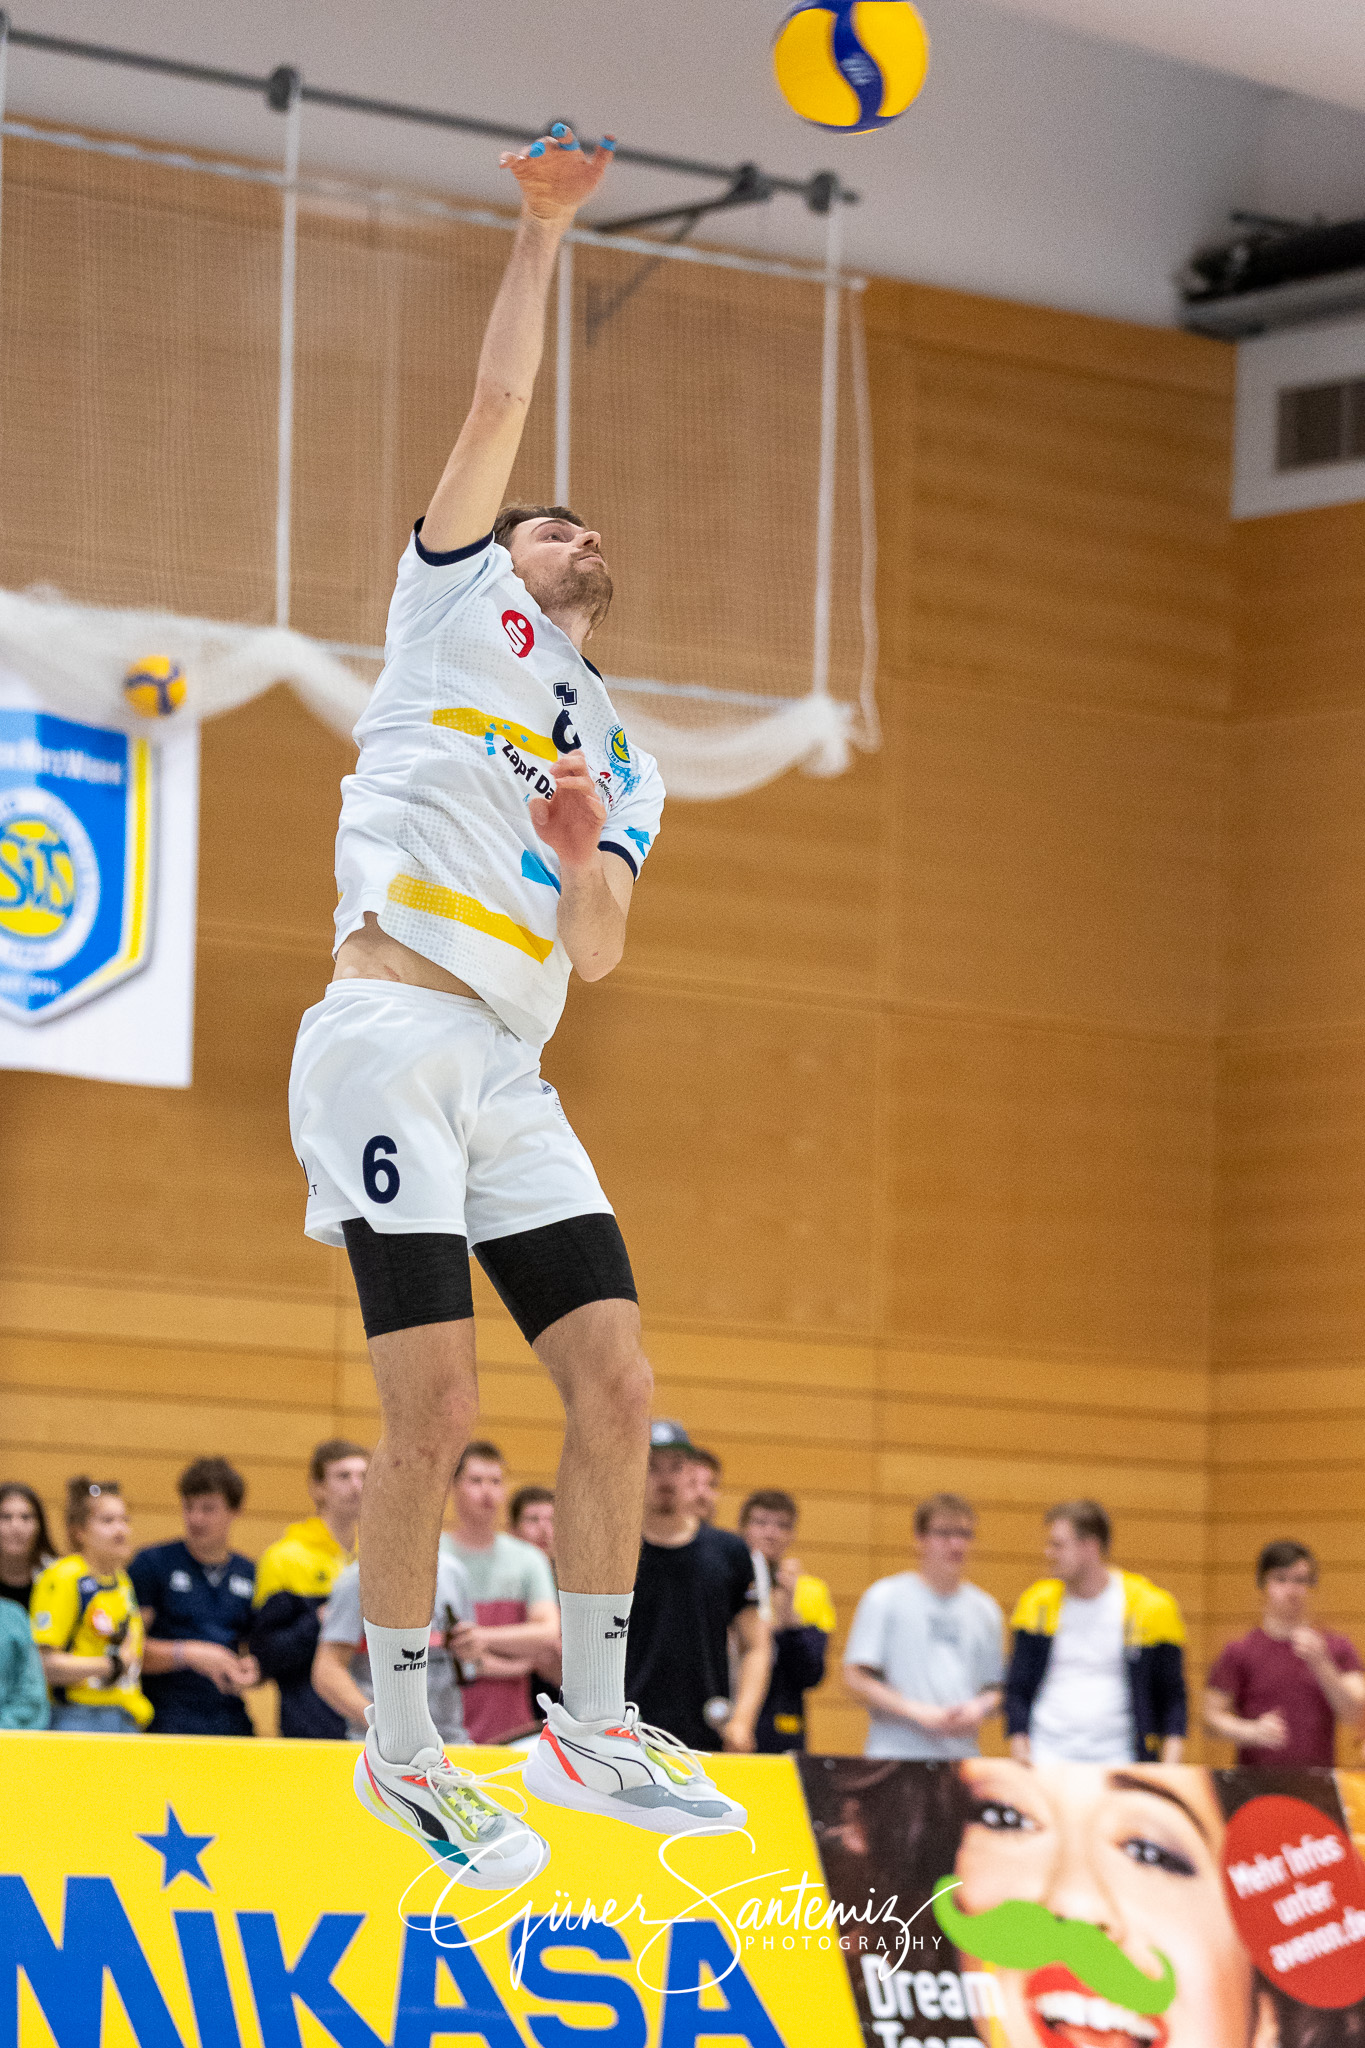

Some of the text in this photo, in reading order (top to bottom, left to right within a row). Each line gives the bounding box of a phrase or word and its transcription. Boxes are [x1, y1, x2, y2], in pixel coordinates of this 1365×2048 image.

[502, 739, 555, 800] Zapf Da
[362, 1134, 400, 1204] 6
[1228, 1852, 1289, 1900] Mehr
[1272, 1880, 1337, 1926] unter
[0, 1874, 787, 2048] MIKASA
[860, 1953, 1007, 2021] Dream
